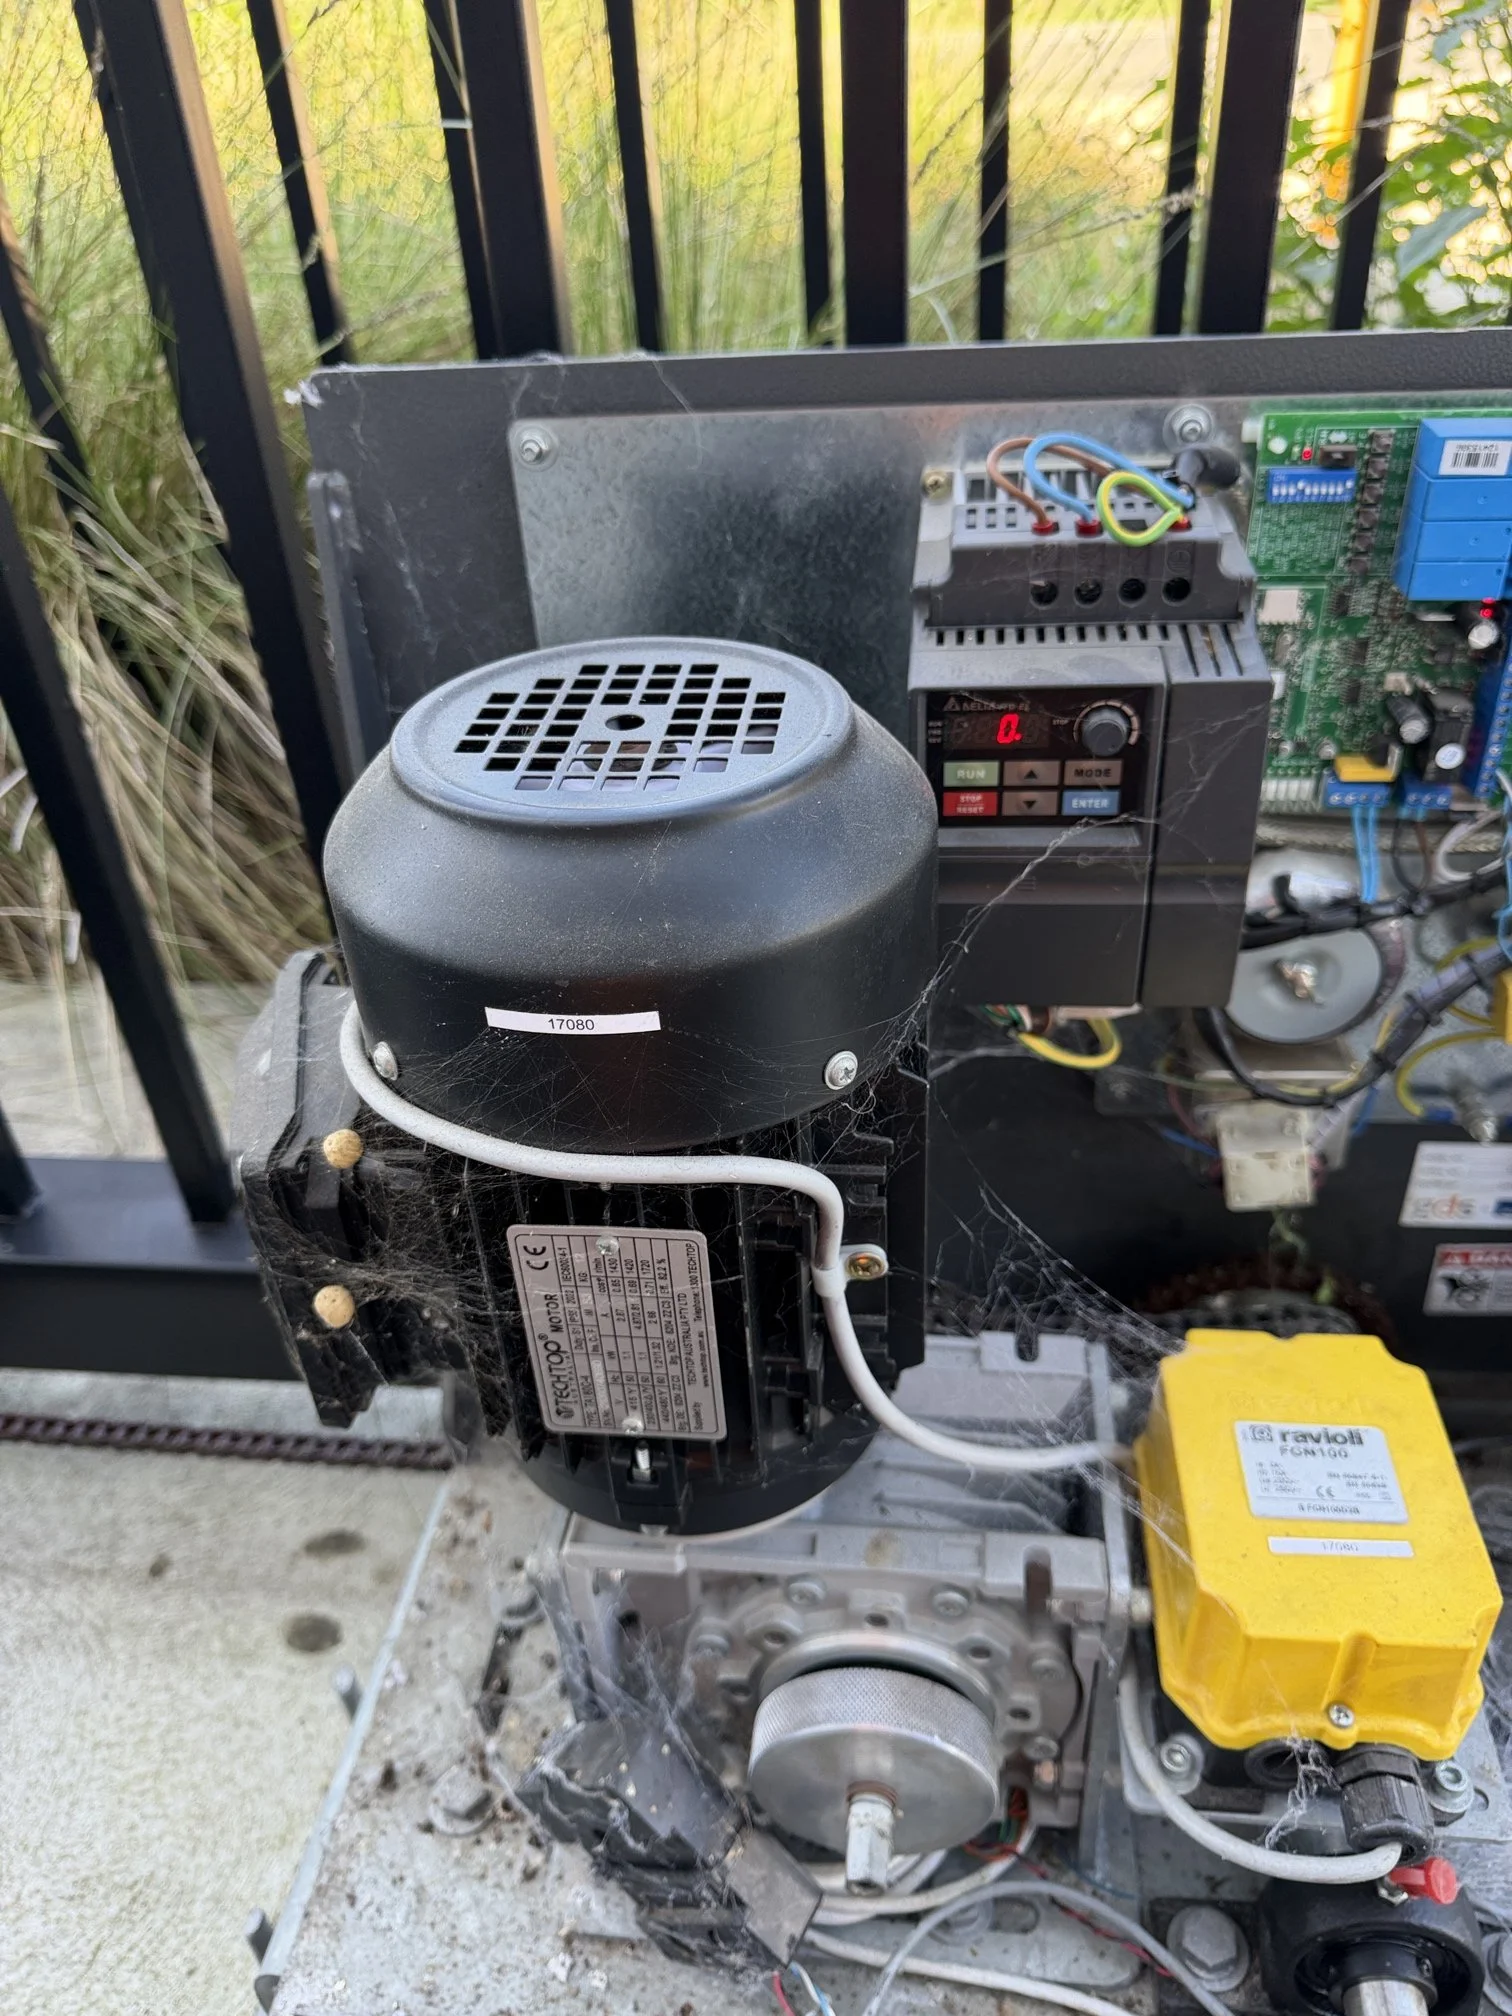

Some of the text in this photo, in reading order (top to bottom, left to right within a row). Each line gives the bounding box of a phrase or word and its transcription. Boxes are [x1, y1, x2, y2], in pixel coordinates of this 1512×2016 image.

[957, 770, 986, 779] RUN
[1074, 768, 1111, 777] MODE
[960, 795, 983, 803] STOP
[1072, 799, 1109, 808] ENTER
[548, 1018, 595, 1031] 17080
[607, 1257, 618, 1273] 1430
[685, 1242, 697, 1274] TECHTOP
[624, 1258, 634, 1274] 1420
[640, 1259, 651, 1274] 1720
[676, 1292, 687, 1305] LTD
[544, 1293, 564, 1332] MOTOR
[679, 1319, 693, 1355] AUSTRALIA
[684, 1355, 697, 1385] TECHTOP
[1280, 1428, 1364, 1446] ravioli
